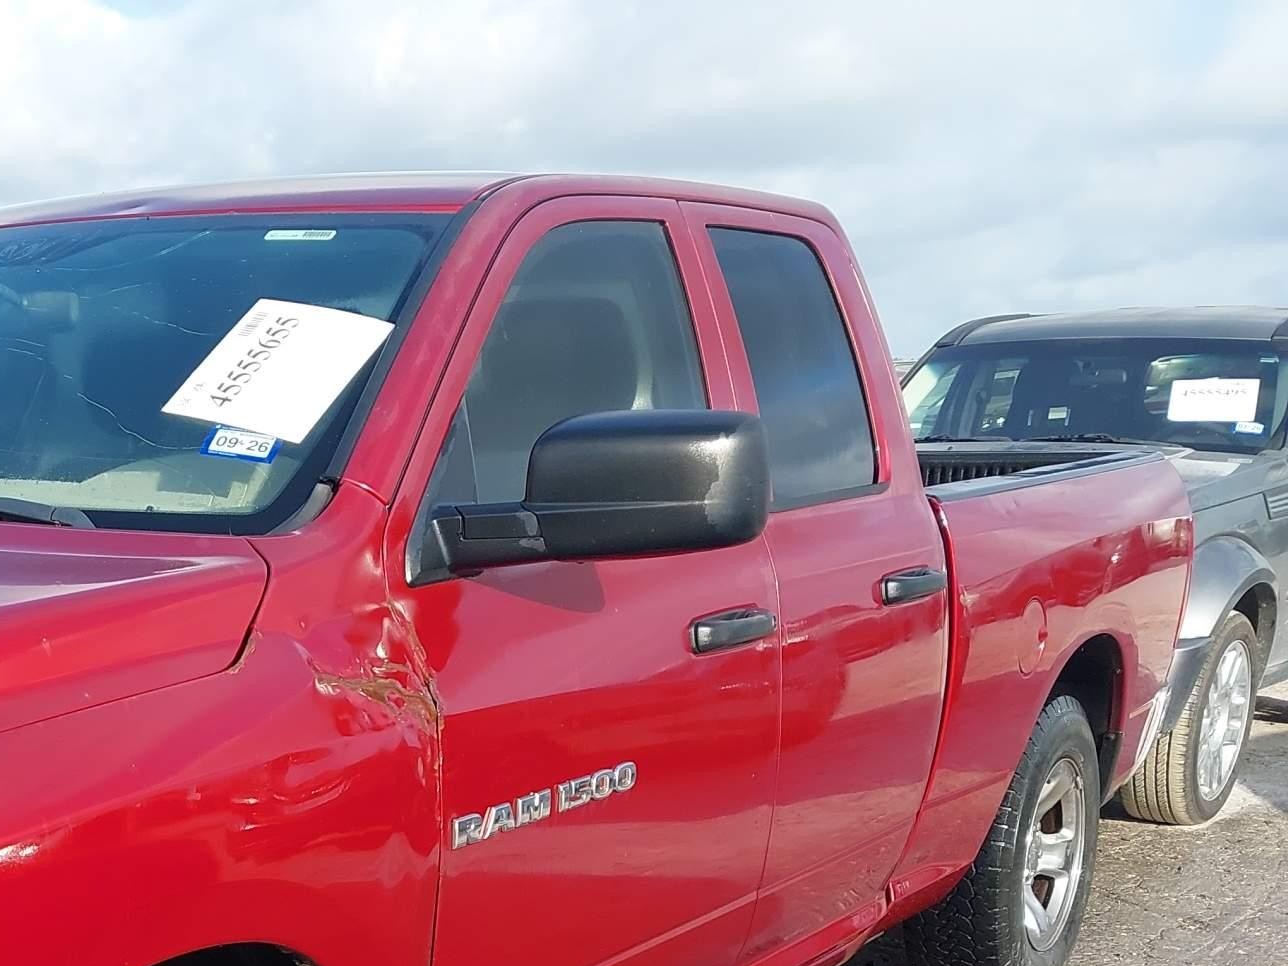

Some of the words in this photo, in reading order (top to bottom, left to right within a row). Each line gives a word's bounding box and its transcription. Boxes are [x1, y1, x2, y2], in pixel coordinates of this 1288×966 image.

[210, 316, 300, 408] 45555655
[451, 788, 552, 850] RAM
[555, 761, 637, 813] 1500
